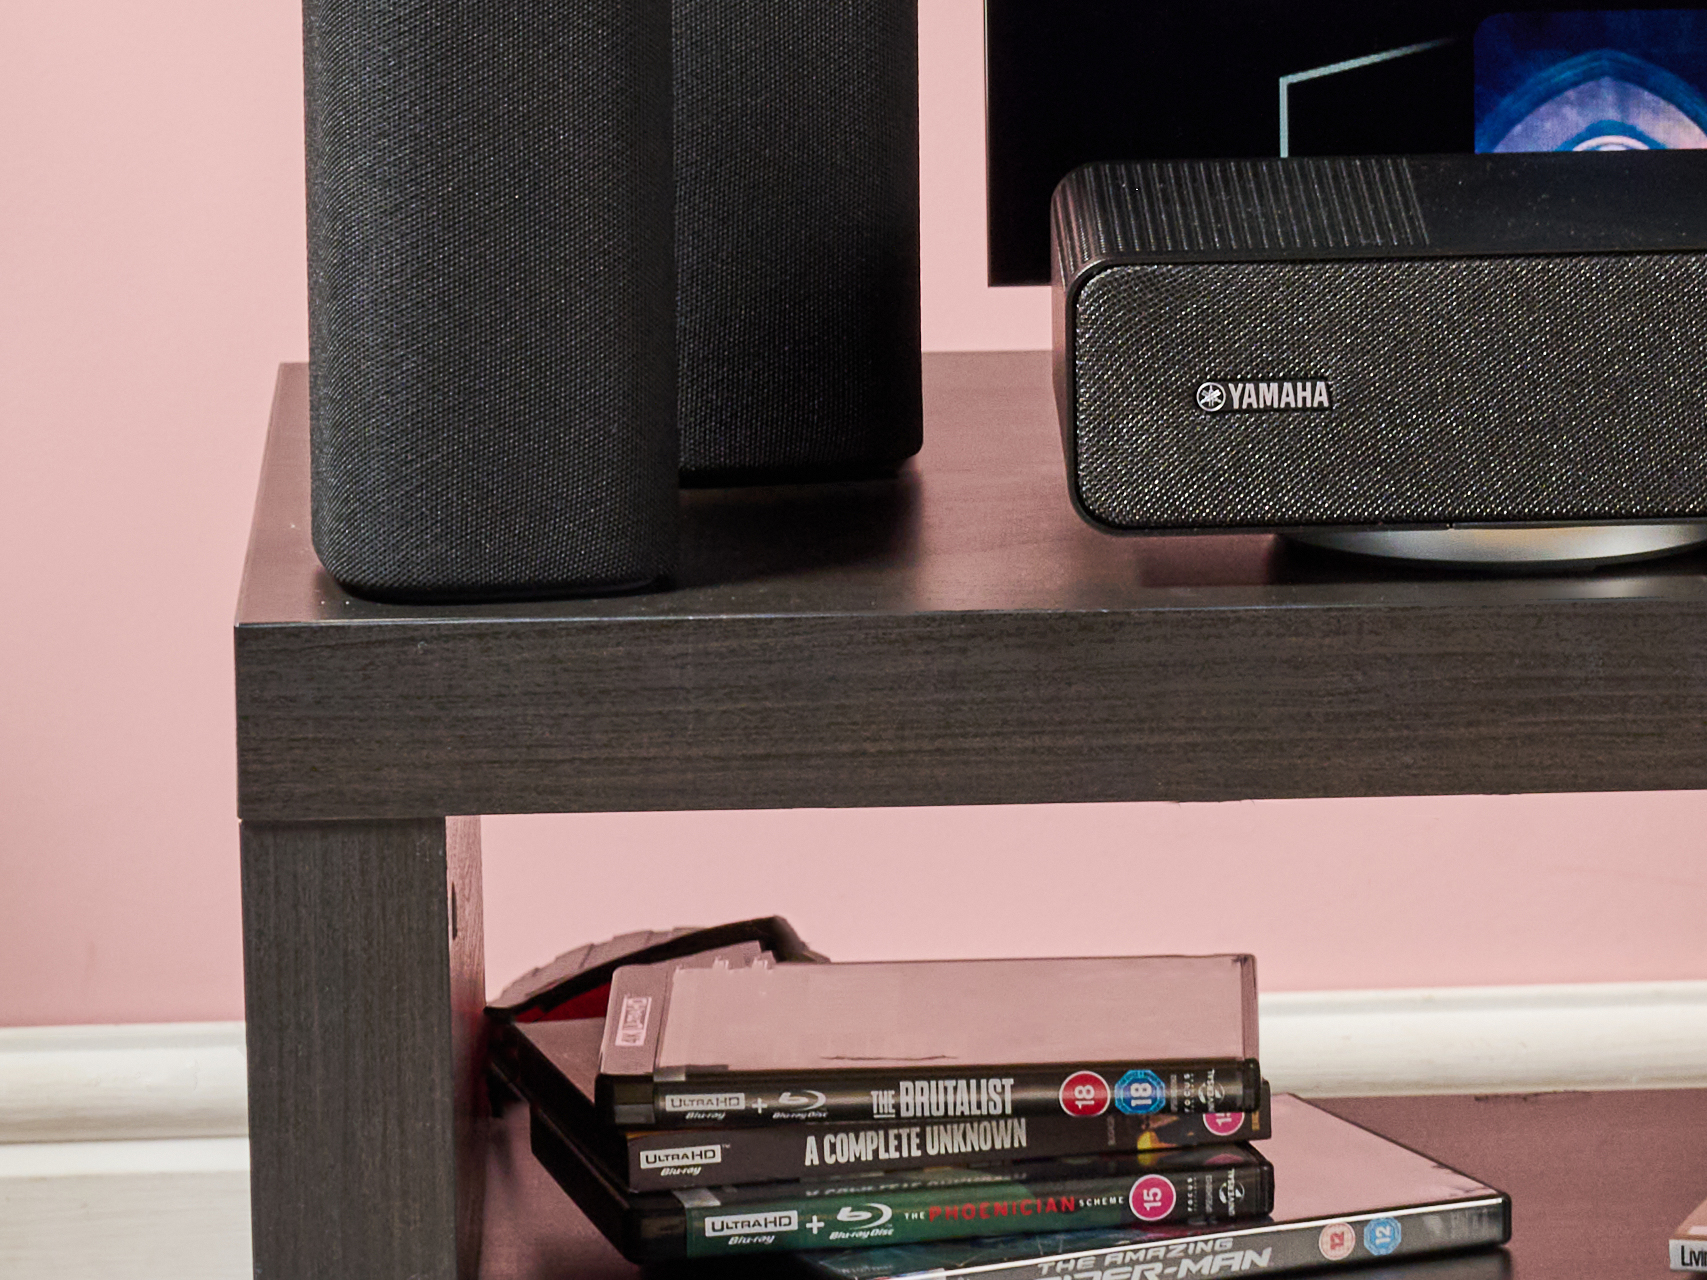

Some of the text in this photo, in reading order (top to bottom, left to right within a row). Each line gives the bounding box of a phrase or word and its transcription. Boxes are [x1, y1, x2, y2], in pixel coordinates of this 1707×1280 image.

[1228, 381, 1330, 410] YAMAHA
[870, 1078, 1014, 1117] THE BRUTALIST
[1074, 1084, 1095, 1110] 18
[1130, 1082, 1152, 1107] 18
[804, 1117, 1027, 1166] A COMPLETE UNKNOWN
[904, 1196, 1125, 1222] THE PHOENICIAN SCHEME
[1142, 1186, 1162, 1212] 15
[728, 1234, 776, 1246] Blu-ray
[1375, 1225, 1391, 1246] 12
[1037, 1238, 1234, 1275] THE AMAZING
